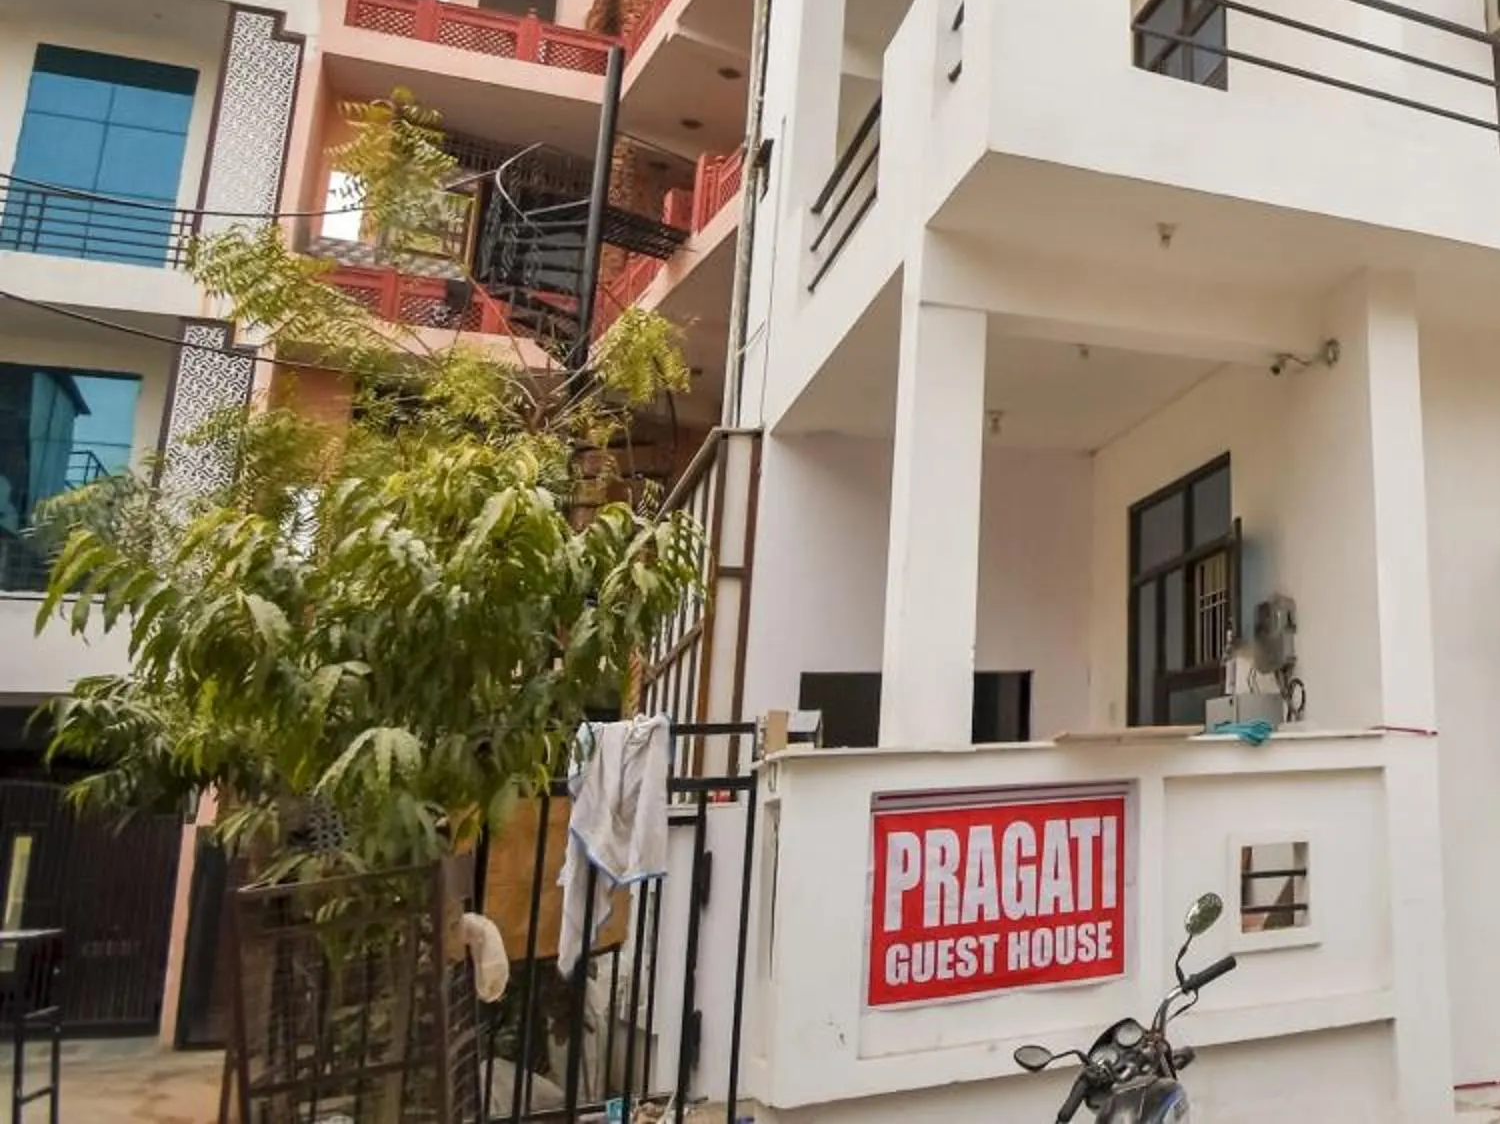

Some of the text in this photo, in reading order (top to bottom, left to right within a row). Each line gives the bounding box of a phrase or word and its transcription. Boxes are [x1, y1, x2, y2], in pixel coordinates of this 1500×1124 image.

[883, 815, 1118, 932] PRAGATI
[885, 921, 1112, 986] GUEST HOUSE
